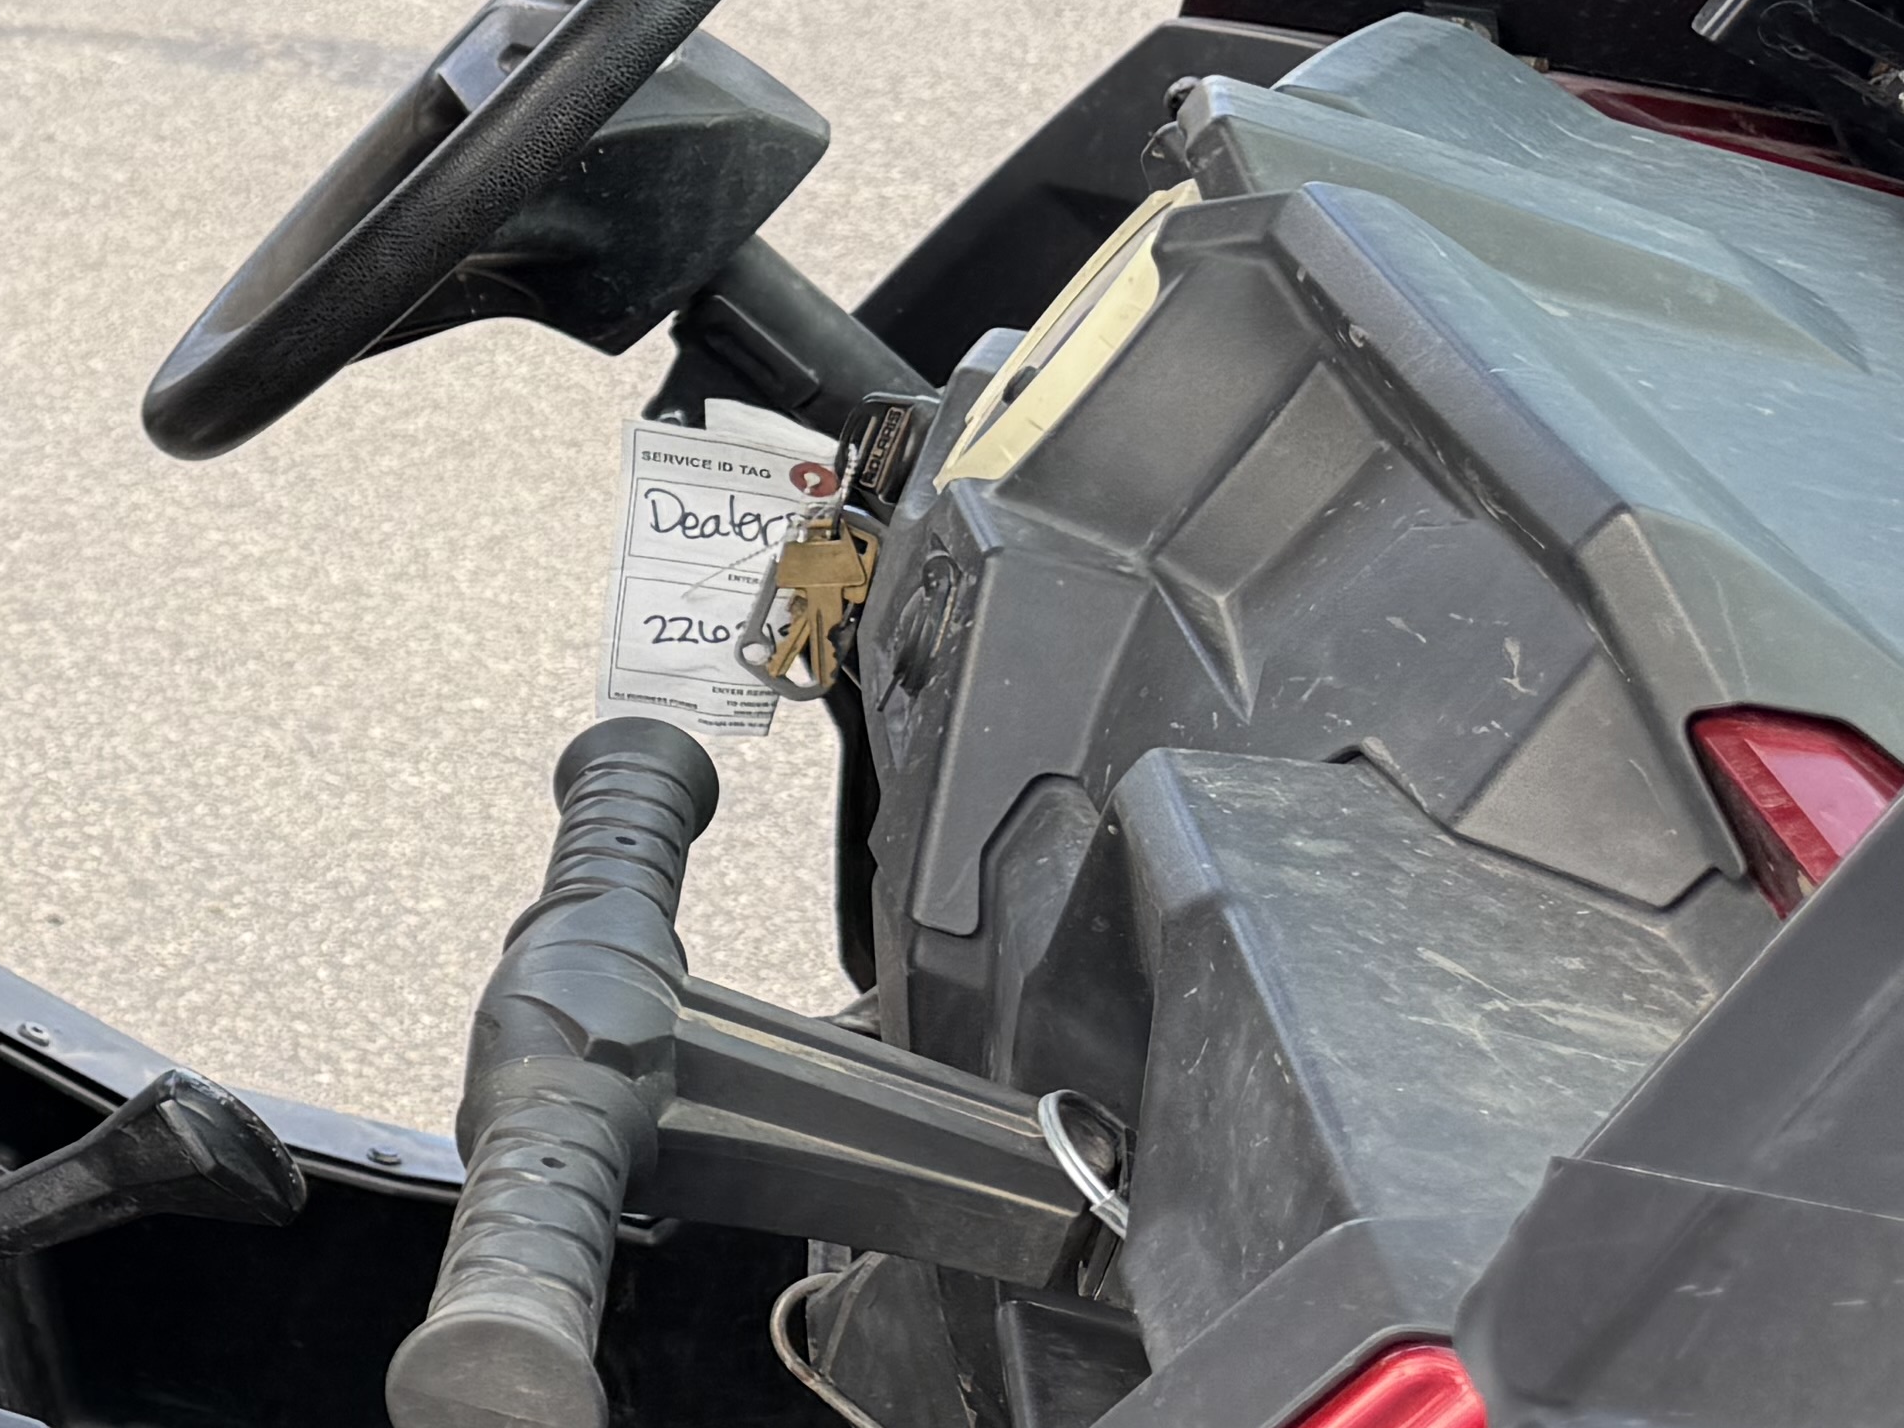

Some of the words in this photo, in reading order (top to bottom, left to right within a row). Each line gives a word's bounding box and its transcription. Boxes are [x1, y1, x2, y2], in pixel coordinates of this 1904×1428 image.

[641, 450, 713, 471] SERVICE
[718, 461, 733, 472] ID
[740, 464, 772, 479] TAG
